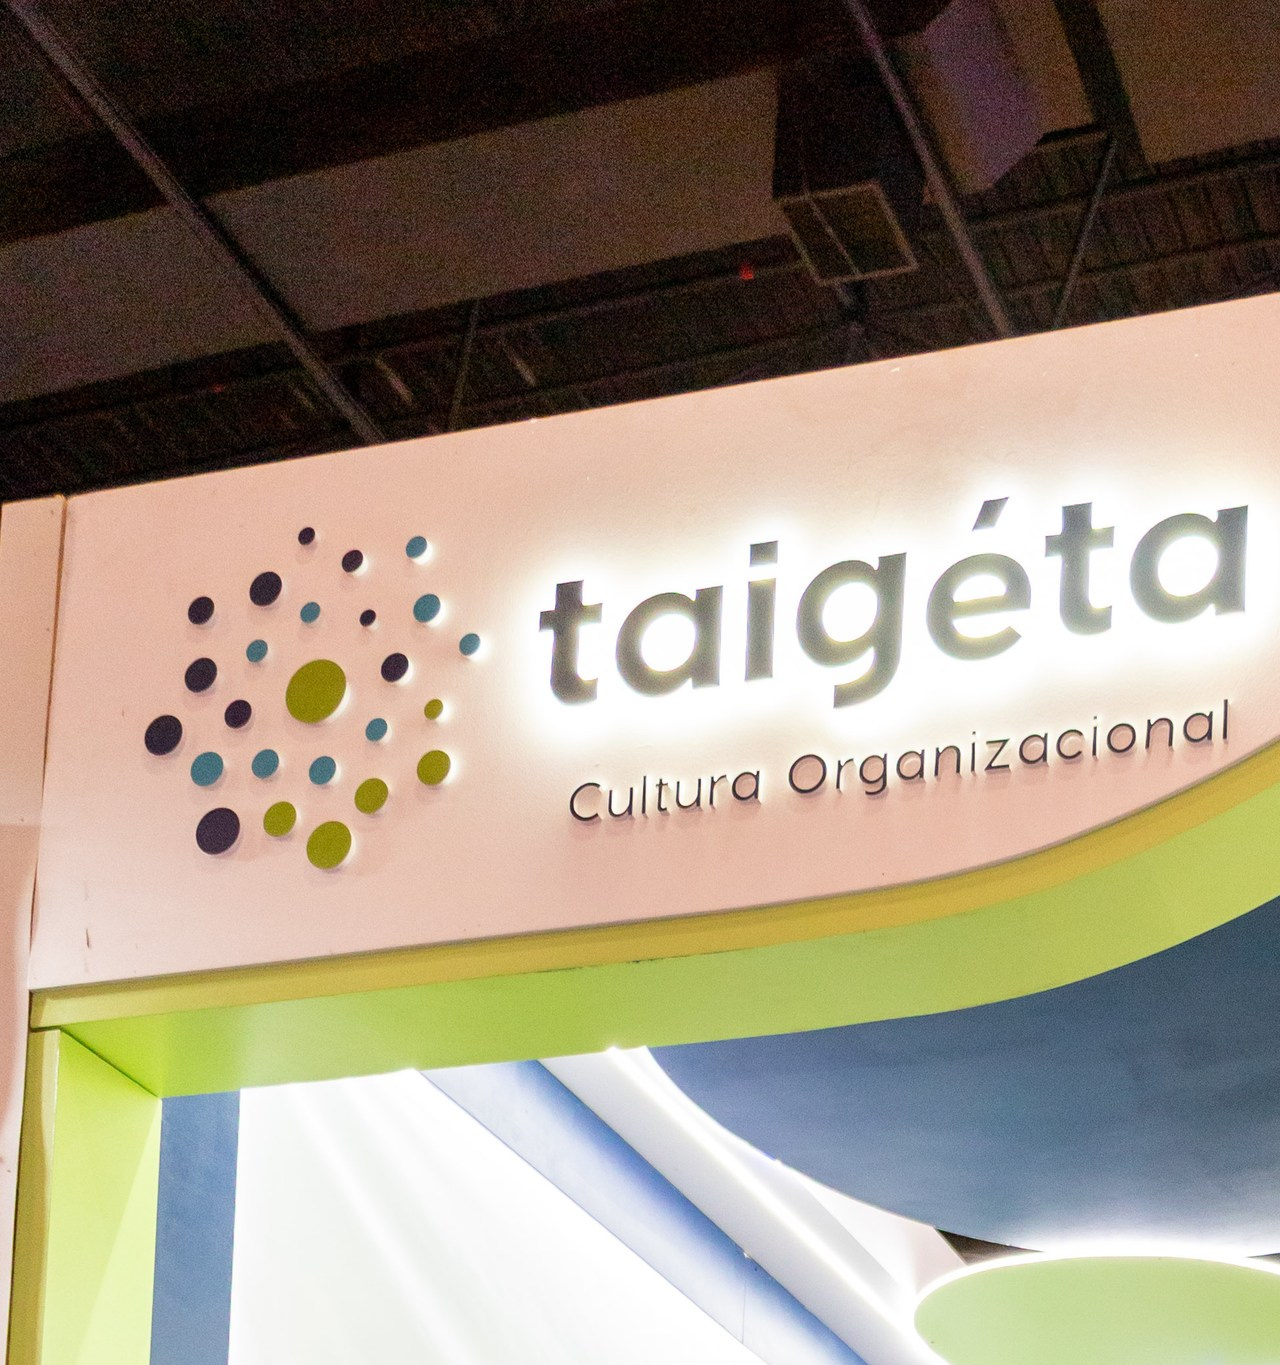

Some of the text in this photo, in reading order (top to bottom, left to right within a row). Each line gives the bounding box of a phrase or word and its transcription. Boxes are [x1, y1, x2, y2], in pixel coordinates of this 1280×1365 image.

[538, 496, 1249, 709] taigéta
[569, 699, 1230, 823] Cultura Organizacional
